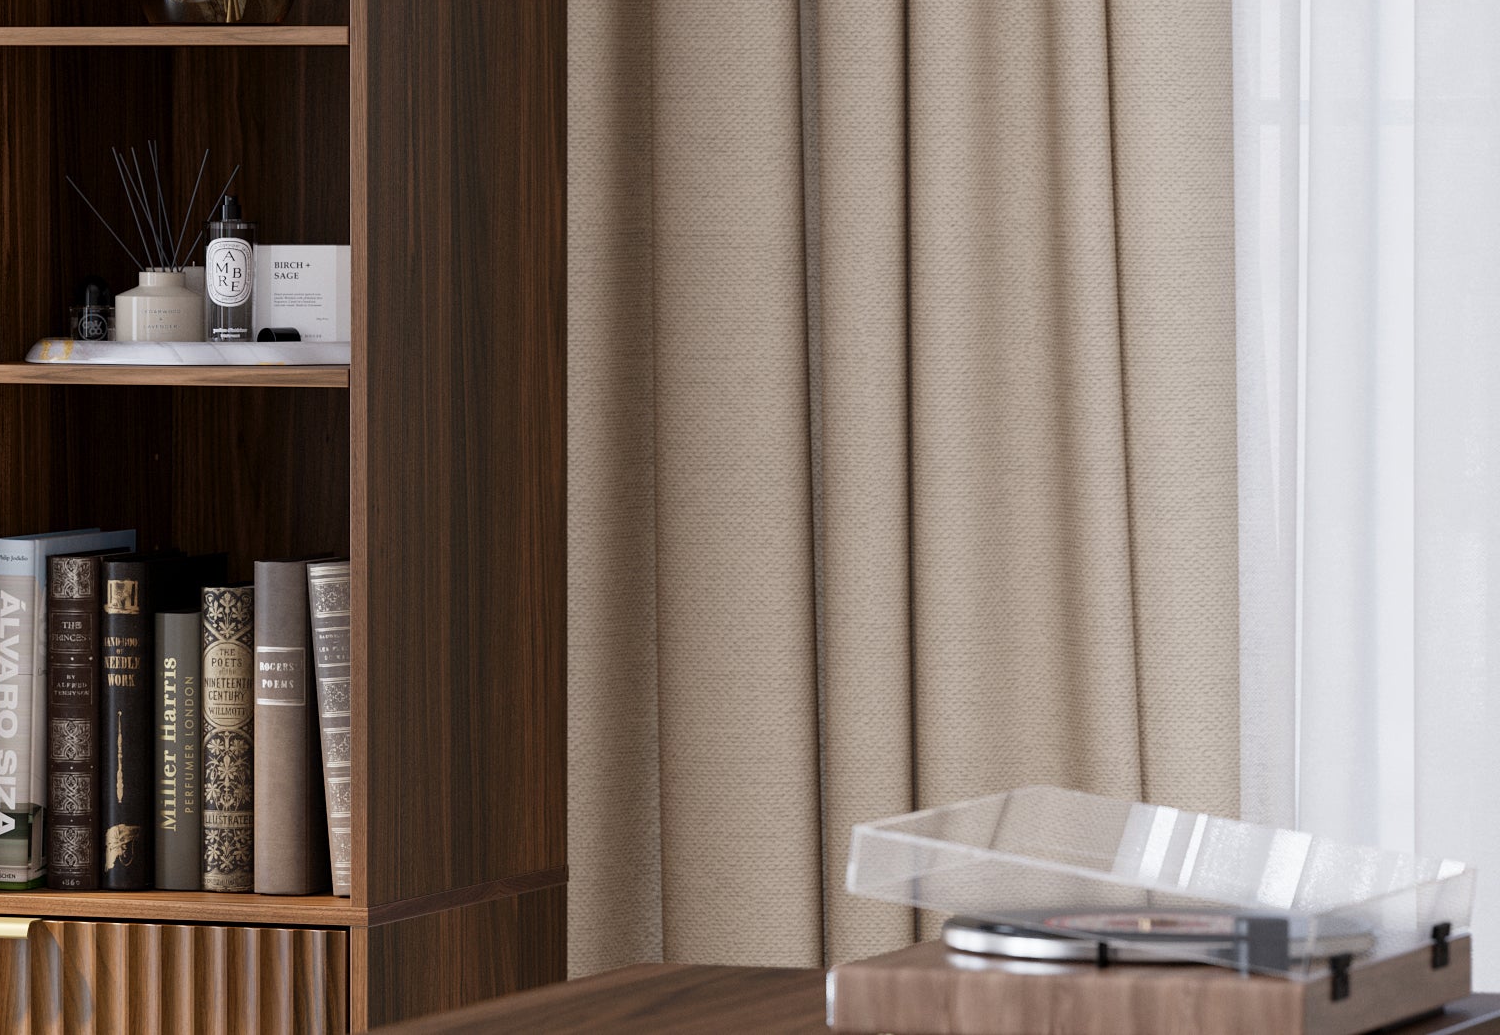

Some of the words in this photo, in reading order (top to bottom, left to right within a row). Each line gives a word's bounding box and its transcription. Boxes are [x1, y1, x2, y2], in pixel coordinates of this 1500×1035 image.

[274, 261, 304, 269] BIRCH
[274, 272, 299, 280] SAGE
[0, 554, 10, 562] Philip
[62, 621, 83, 630] THE
[220, 648, 236, 656] THE
[211, 658, 242, 667] POETS
[107, 673, 136, 687] WORK
[261, 678, 295, 689] POEMS
[159, 657, 177, 743] Harris
[208, 690, 245, 701] CENTURY
[184, 676, 194, 736] LONDON
[208, 707, 246, 717] WILLMOTT
[184, 745, 194, 813] PERFUMER
[160, 750, 177, 833] Miller
